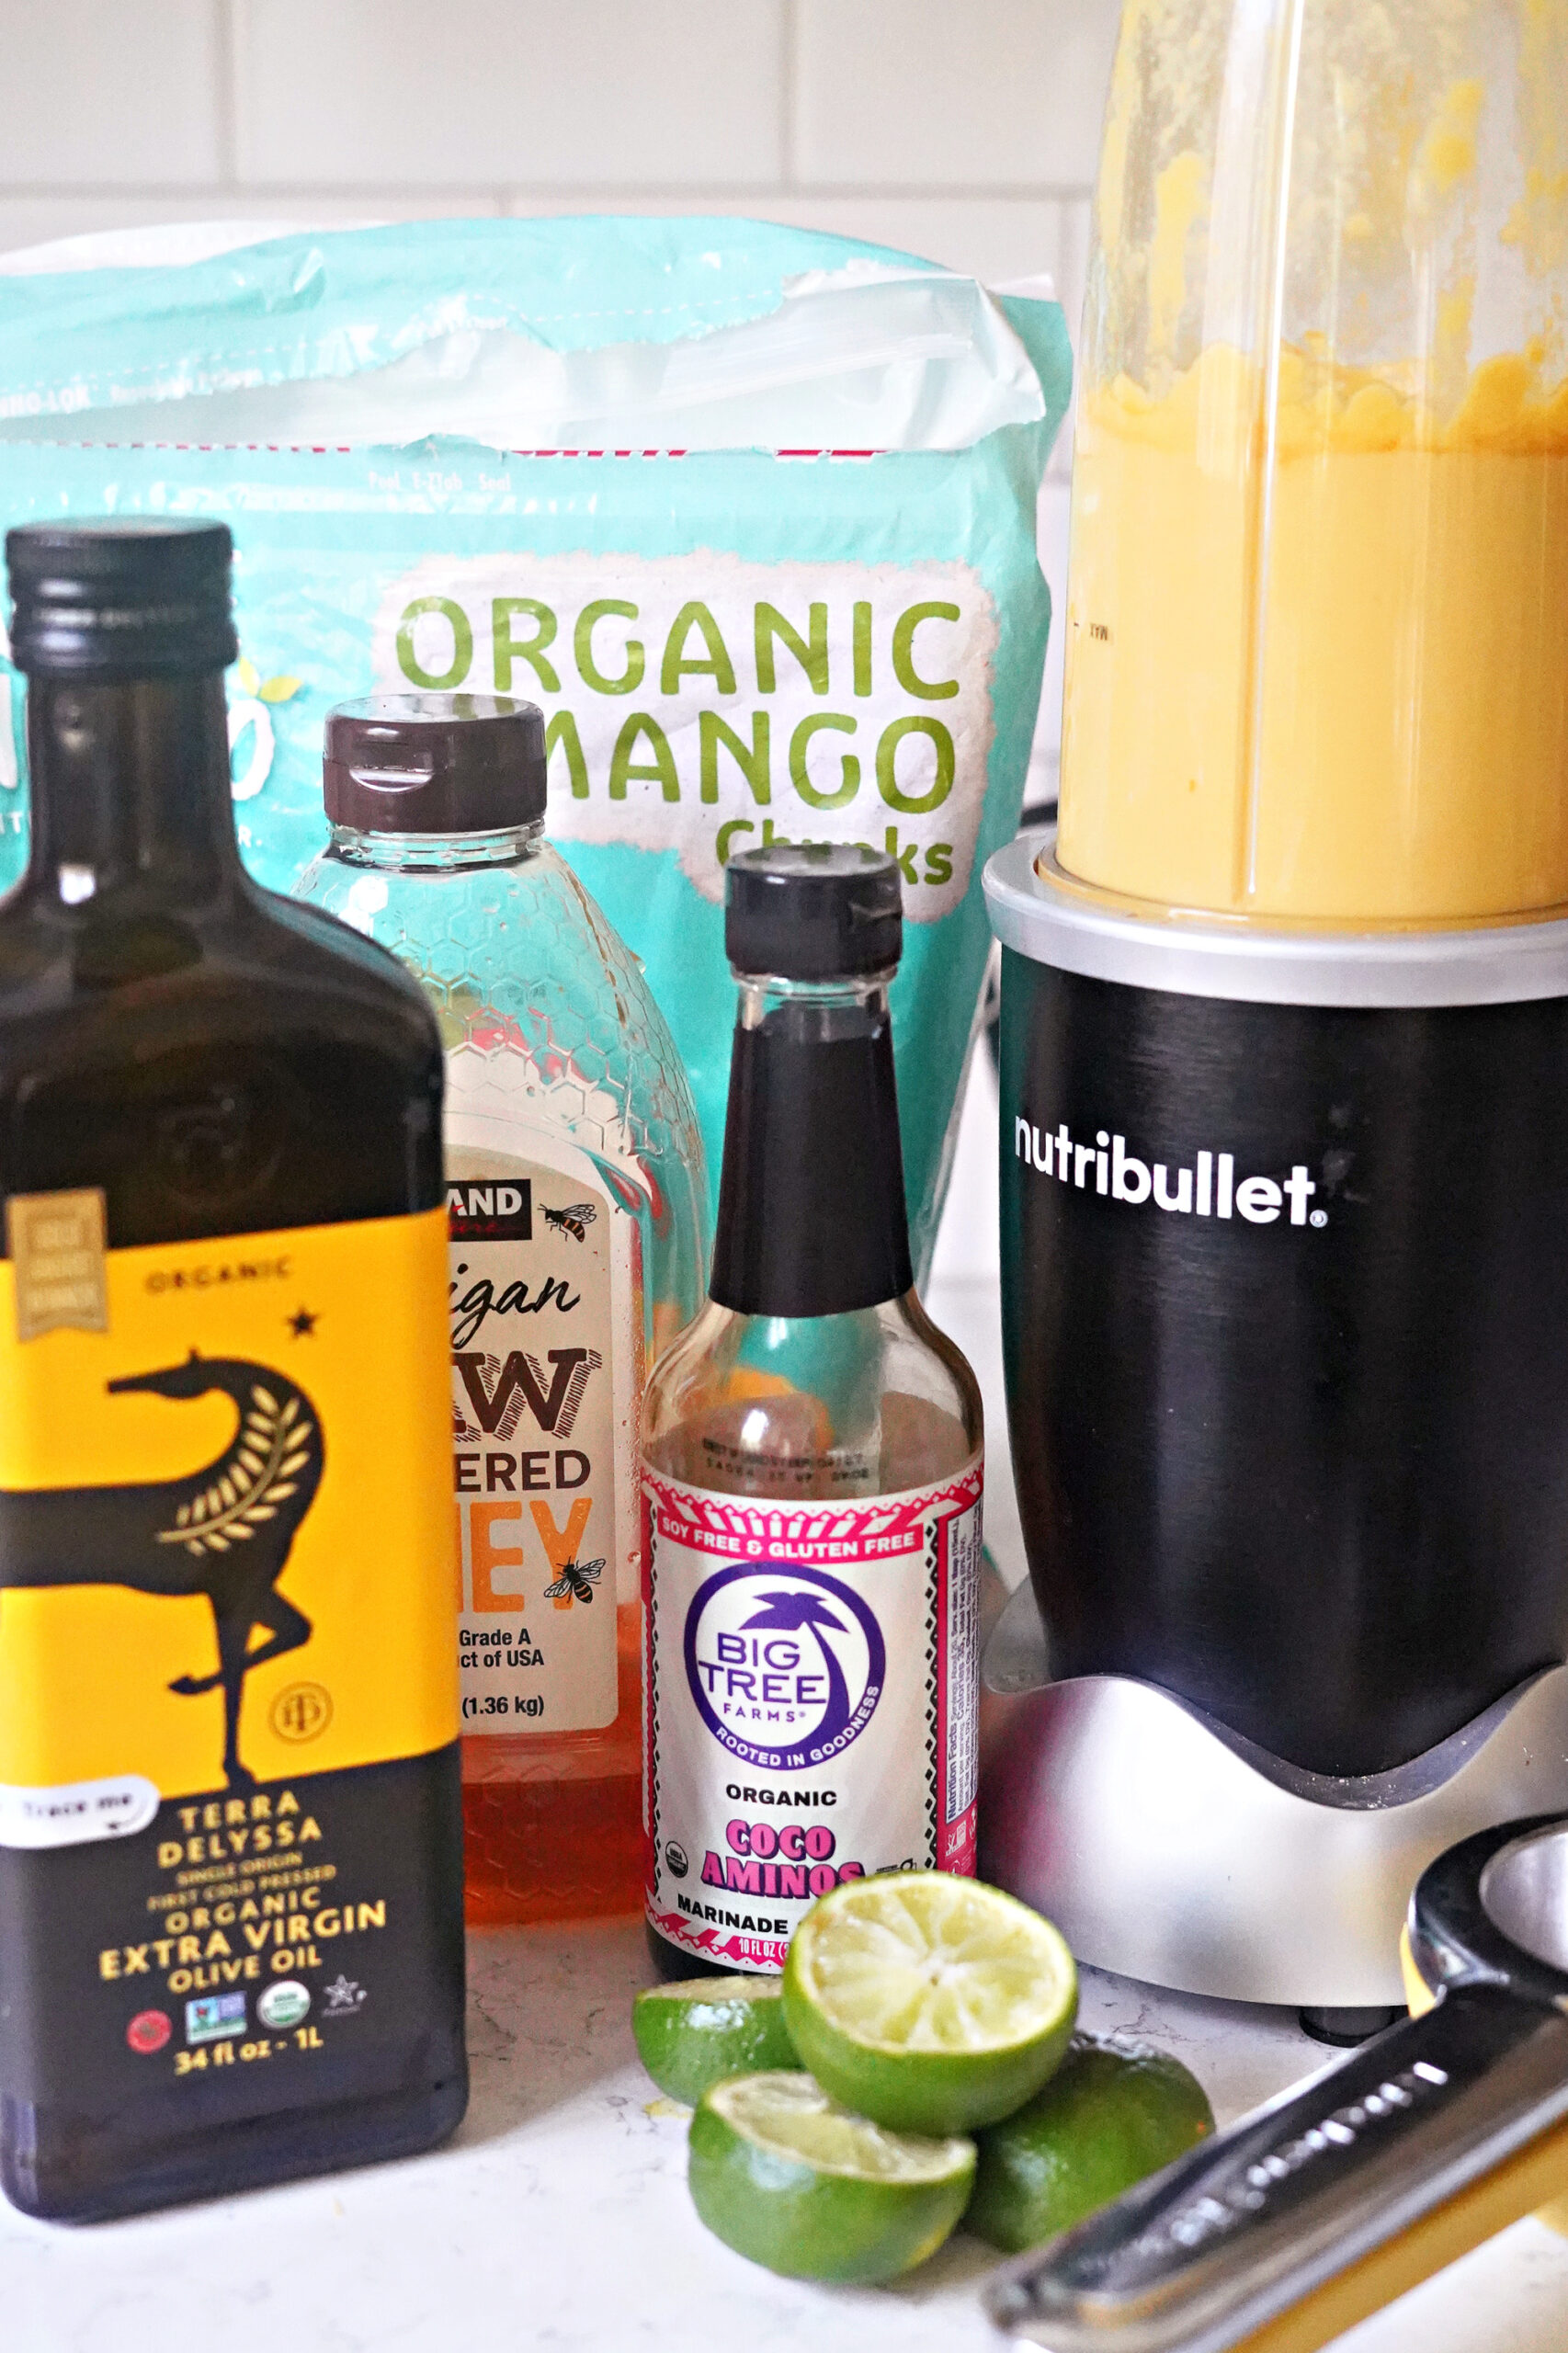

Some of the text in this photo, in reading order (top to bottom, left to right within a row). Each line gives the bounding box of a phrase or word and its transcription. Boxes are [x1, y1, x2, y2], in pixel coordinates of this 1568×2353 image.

[395, 596, 960, 700] ORGANIC
[716, 819, 953, 885] Chks
[1015, 1115, 1316, 1226] nutribullet
[663, 1518, 915, 1559] SOY FREE & GLUTEN FREE
[460, 1628, 531, 1646] Grade A
[483, 1651, 501, 1667] of
[506, 1649, 544, 1666] USA
[718, 1632, 801, 1670] BIG
[699, 1660, 826, 1704] TREE
[461, 1695, 544, 1717] (1.36 kg)
[716, 1686, 880, 1767] ROOTED IN GOODNESS
[724, 1702, 797, 1722] FARMS
[948, 1722, 957, 1761] Facts
[178, 1790, 300, 1833] TERRA
[726, 1784, 837, 1806] ORGANIC
[948, 1761, 957, 1820] Nutrition
[157, 1816, 323, 1869] DELYSSA
[726, 1819, 835, 1862] COCO
[165, 1886, 321, 1934] ORGANIC
[677, 1893, 789, 1935] MARINADE
[99, 1899, 387, 1980] EXTRA VIRGIN
[739, 1938, 750, 1954] 10
[752, 1940, 762, 1956] FL
[763, 1942, 775, 1958] OZ
[167, 1945, 324, 1995] OLIVE OIL
[175, 2050, 209, 2076] 34
[293, 2026, 324, 2050] 1L
